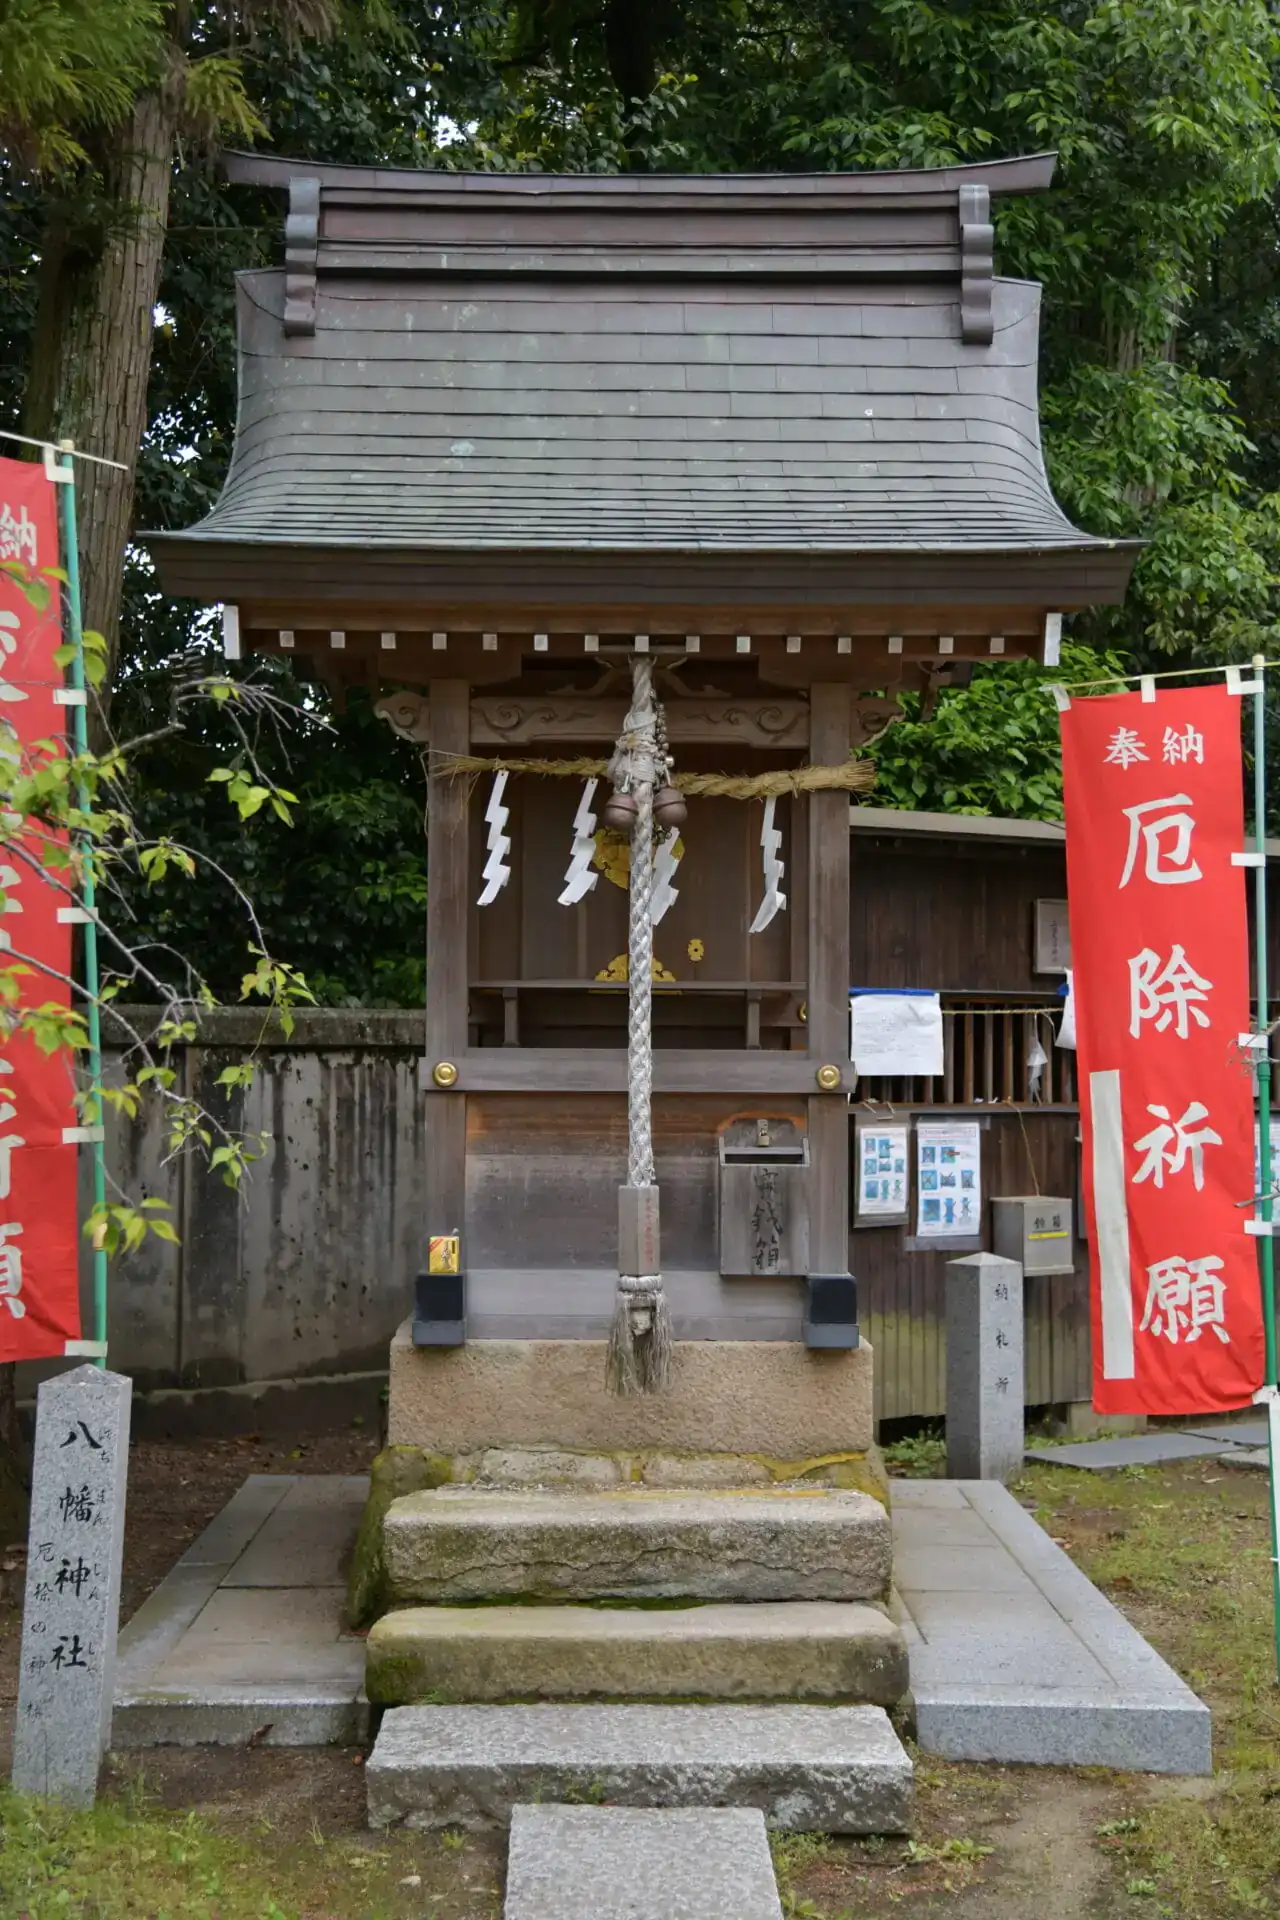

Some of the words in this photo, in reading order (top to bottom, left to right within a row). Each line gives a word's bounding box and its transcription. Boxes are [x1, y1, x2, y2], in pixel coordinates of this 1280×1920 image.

[1103, 723, 1205, 771] 奉納
[1117, 792, 1231, 1346] 厄除祈願
[994, 1283, 1010, 1396] 納札所
[49, 1420, 102, 1672] 八幡神社
